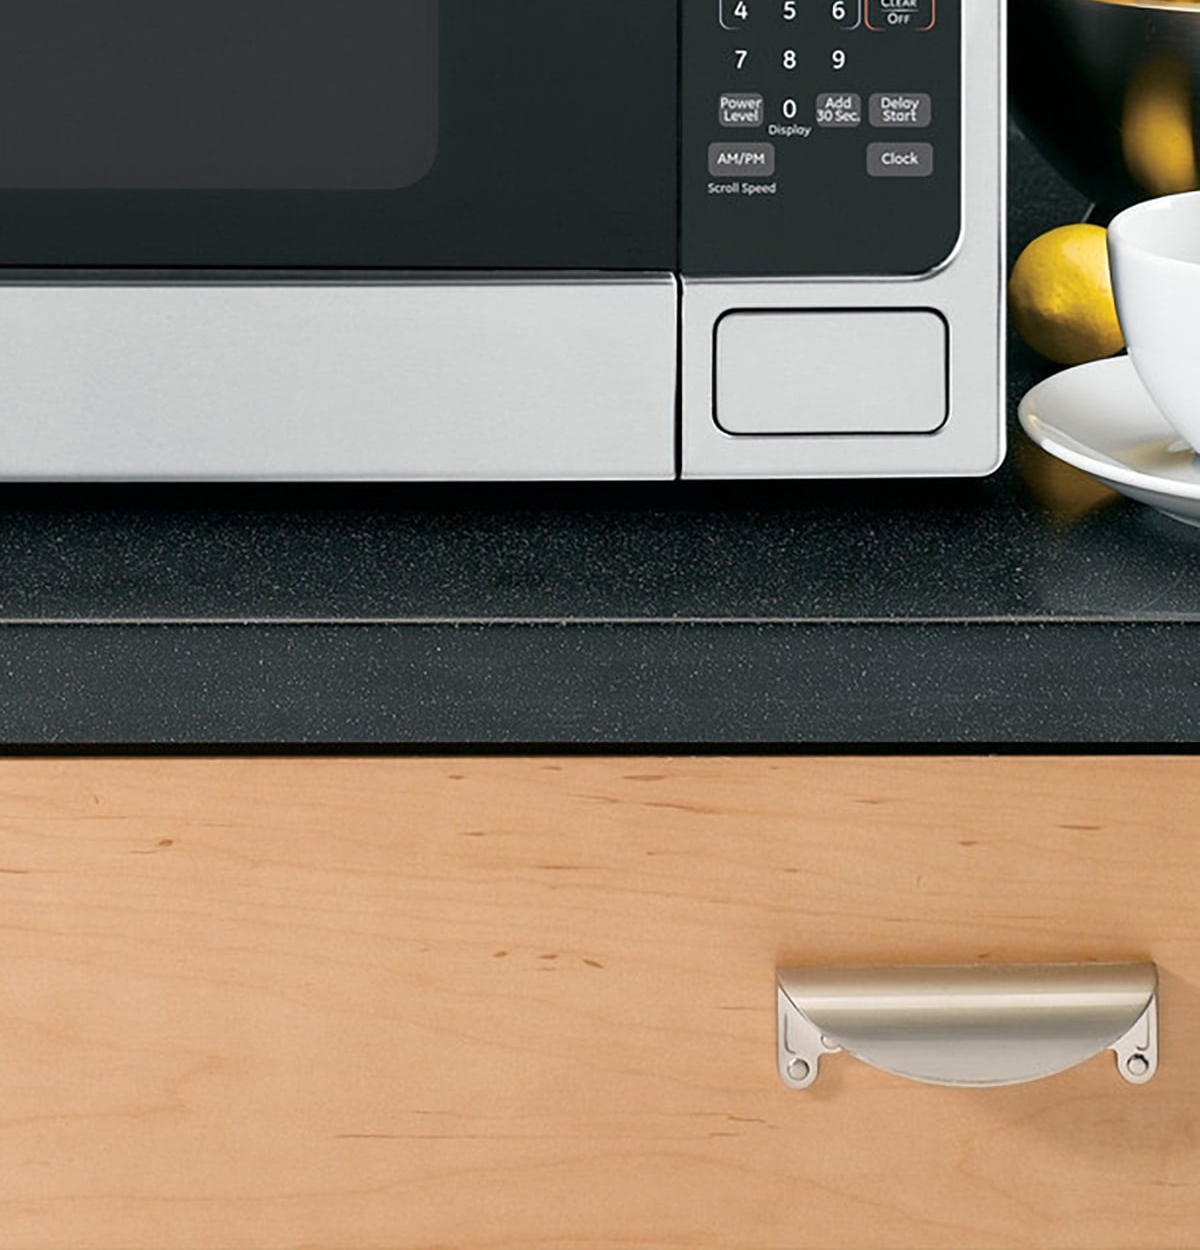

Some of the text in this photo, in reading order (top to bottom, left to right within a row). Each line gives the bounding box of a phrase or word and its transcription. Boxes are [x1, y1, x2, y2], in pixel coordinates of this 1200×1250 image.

[734, 0, 748, 20] 4
[783, 0, 797, 20] 5
[832, 0, 846, 20] 6
[735, 49, 748, 69] 7
[783, 49, 797, 70] 8
[832, 49, 846, 70] 9
[720, 96, 763, 109] Power
[782, 98, 797, 119] 0
[824, 96, 852, 109] Add
[880, 96, 920, 112] Delay
[723, 109, 759, 122] Level
[816, 109, 861, 123] 30 Sec.
[882, 108, 917, 122] Start
[768, 123, 812, 138] Display
[717, 152, 765, 165] AM/PM
[881, 151, 919, 165] Clock
[707, 182, 777, 196] Scroll Speed
